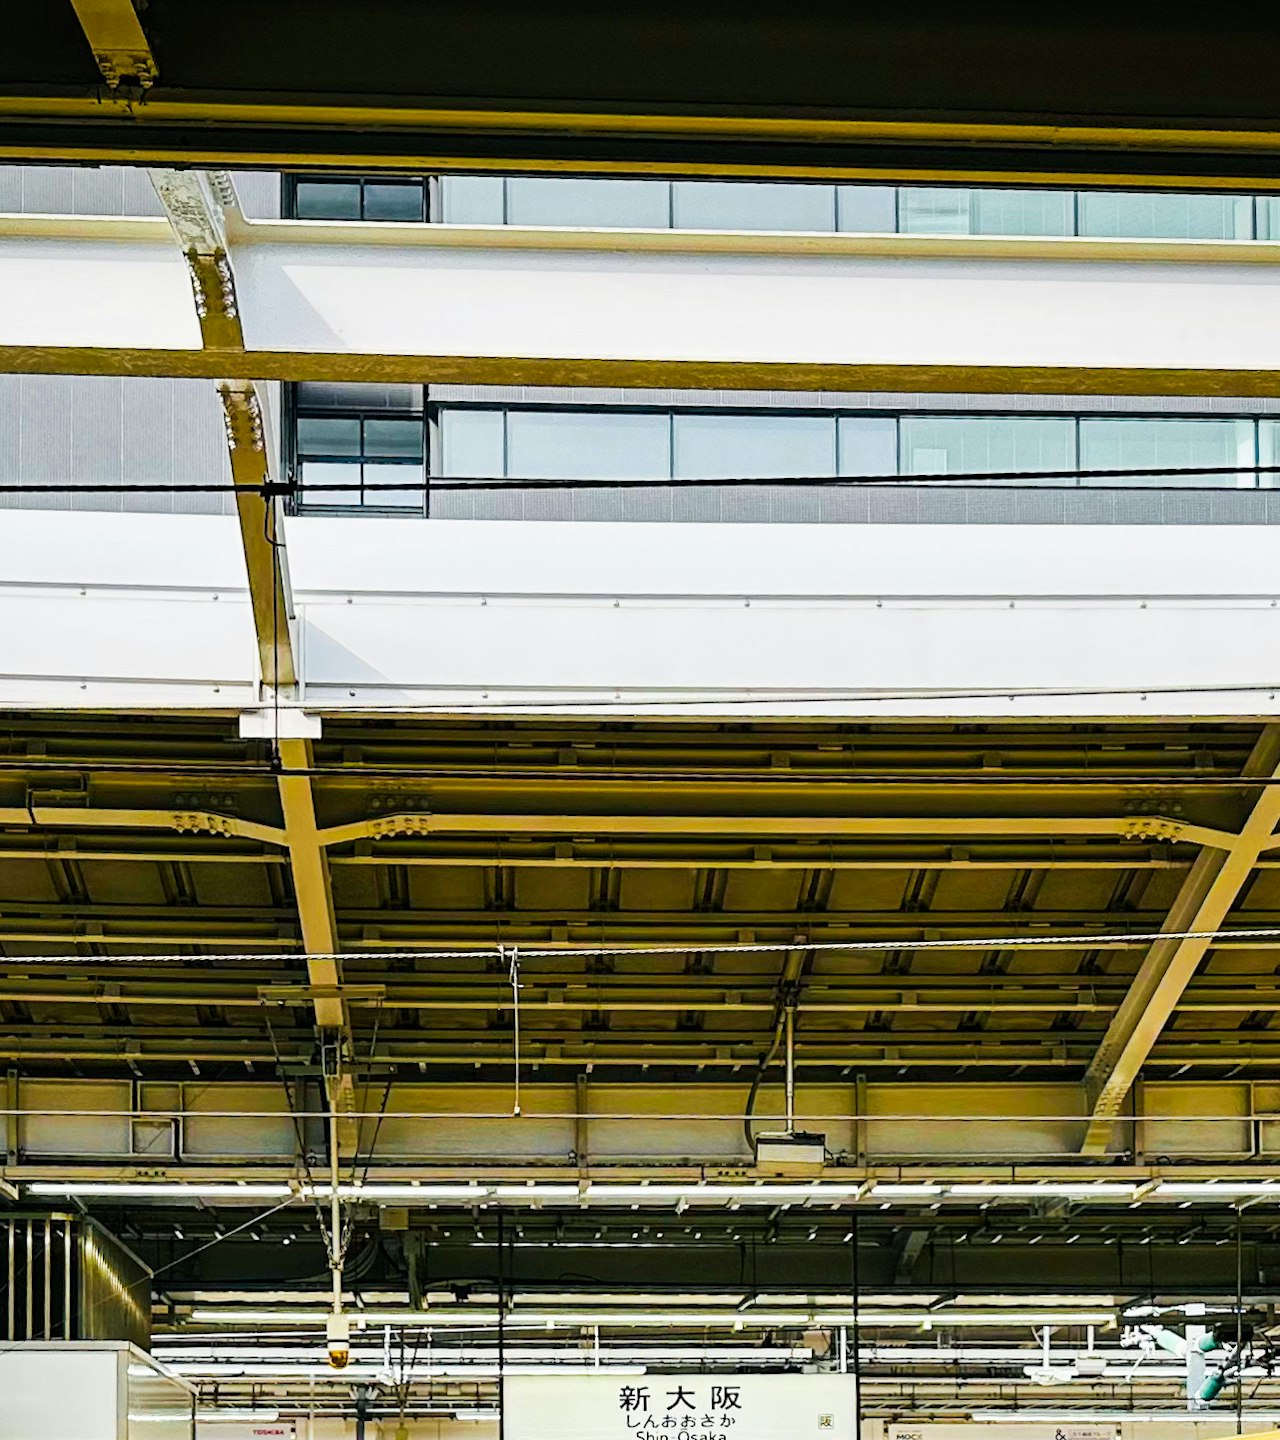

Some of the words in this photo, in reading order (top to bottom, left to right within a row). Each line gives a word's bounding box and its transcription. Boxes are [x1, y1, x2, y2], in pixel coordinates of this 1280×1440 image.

[620, 1386, 742, 1411] 新大阪
[626, 1413, 736, 1428] しんおおさか
